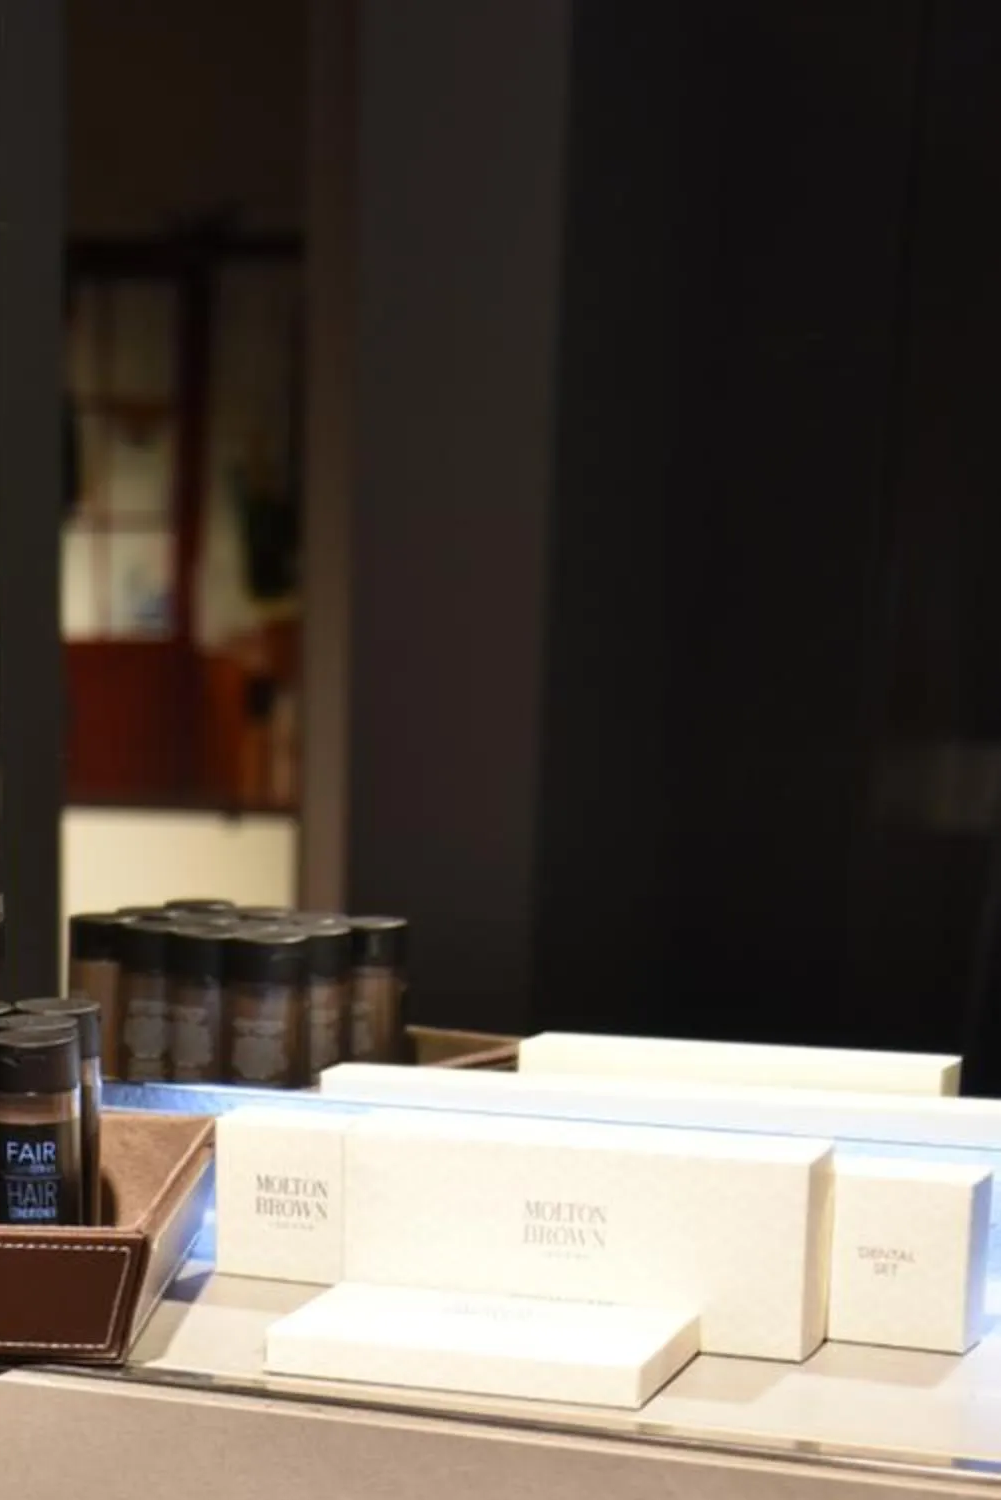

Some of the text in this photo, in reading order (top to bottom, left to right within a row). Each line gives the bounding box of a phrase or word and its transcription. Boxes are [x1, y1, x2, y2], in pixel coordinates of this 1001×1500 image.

[6, 1140, 56, 1164] FAIR
[6, 1180, 58, 1207] HAIR
[255, 1174, 328, 1199] MOLTON
[255, 1196, 329, 1220] BROWN
[523, 1200, 608, 1225] MOLTON
